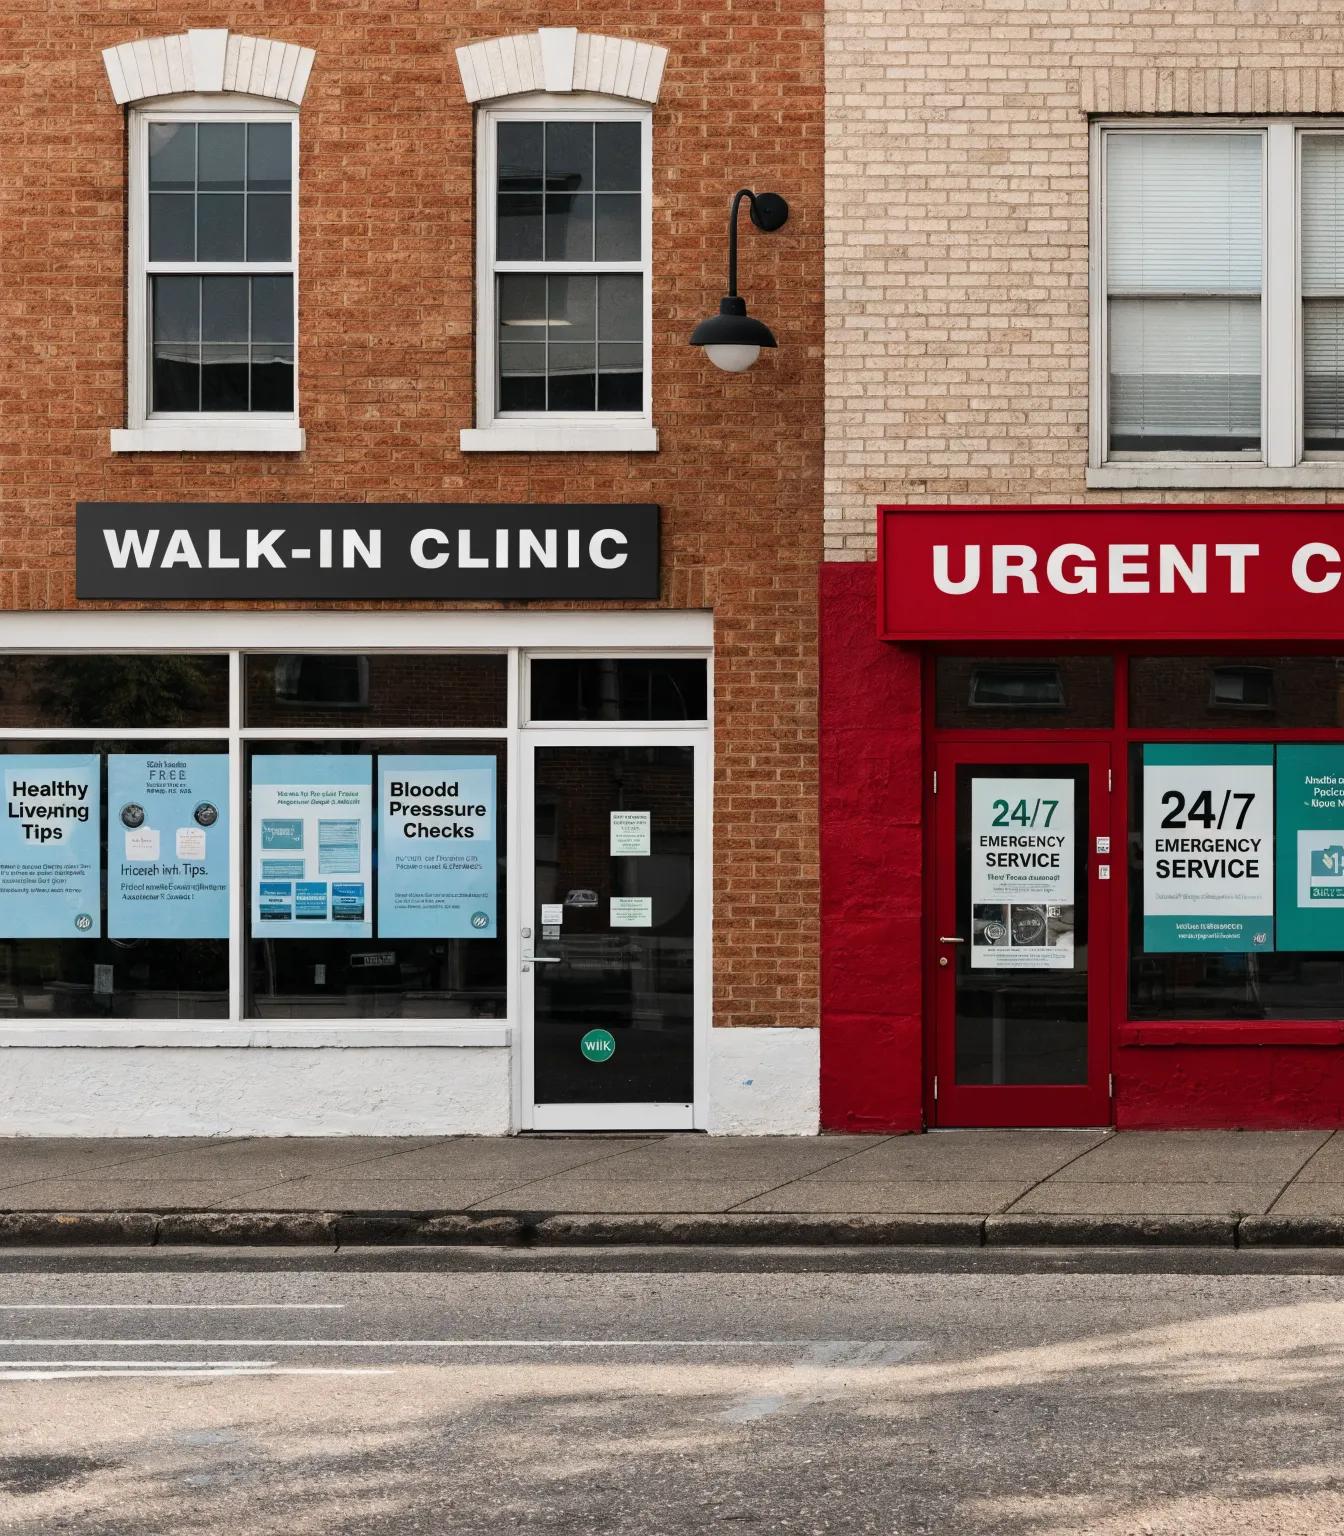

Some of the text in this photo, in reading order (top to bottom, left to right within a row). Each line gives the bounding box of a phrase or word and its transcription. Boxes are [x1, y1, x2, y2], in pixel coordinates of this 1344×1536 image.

[102, 528, 628, 570] WALK-IN CLINIC
[932, 542, 1260, 595] URGENT
[12, 780, 89, 800] Healthy
[390, 781, 459, 798] Bloodd
[389, 801, 487, 817] Presssure
[991, 798, 1060, 828] 24/7
[1160, 789, 1256, 830] 24/7
[21, 823, 63, 843] Tips
[403, 822, 475, 839] Checks
[979, 835, 1065, 848] EMERGENCY
[1155, 838, 1262, 853] EMERGENCY
[985, 852, 1060, 868] SERVICE
[1155, 858, 1260, 879] SERVICE
